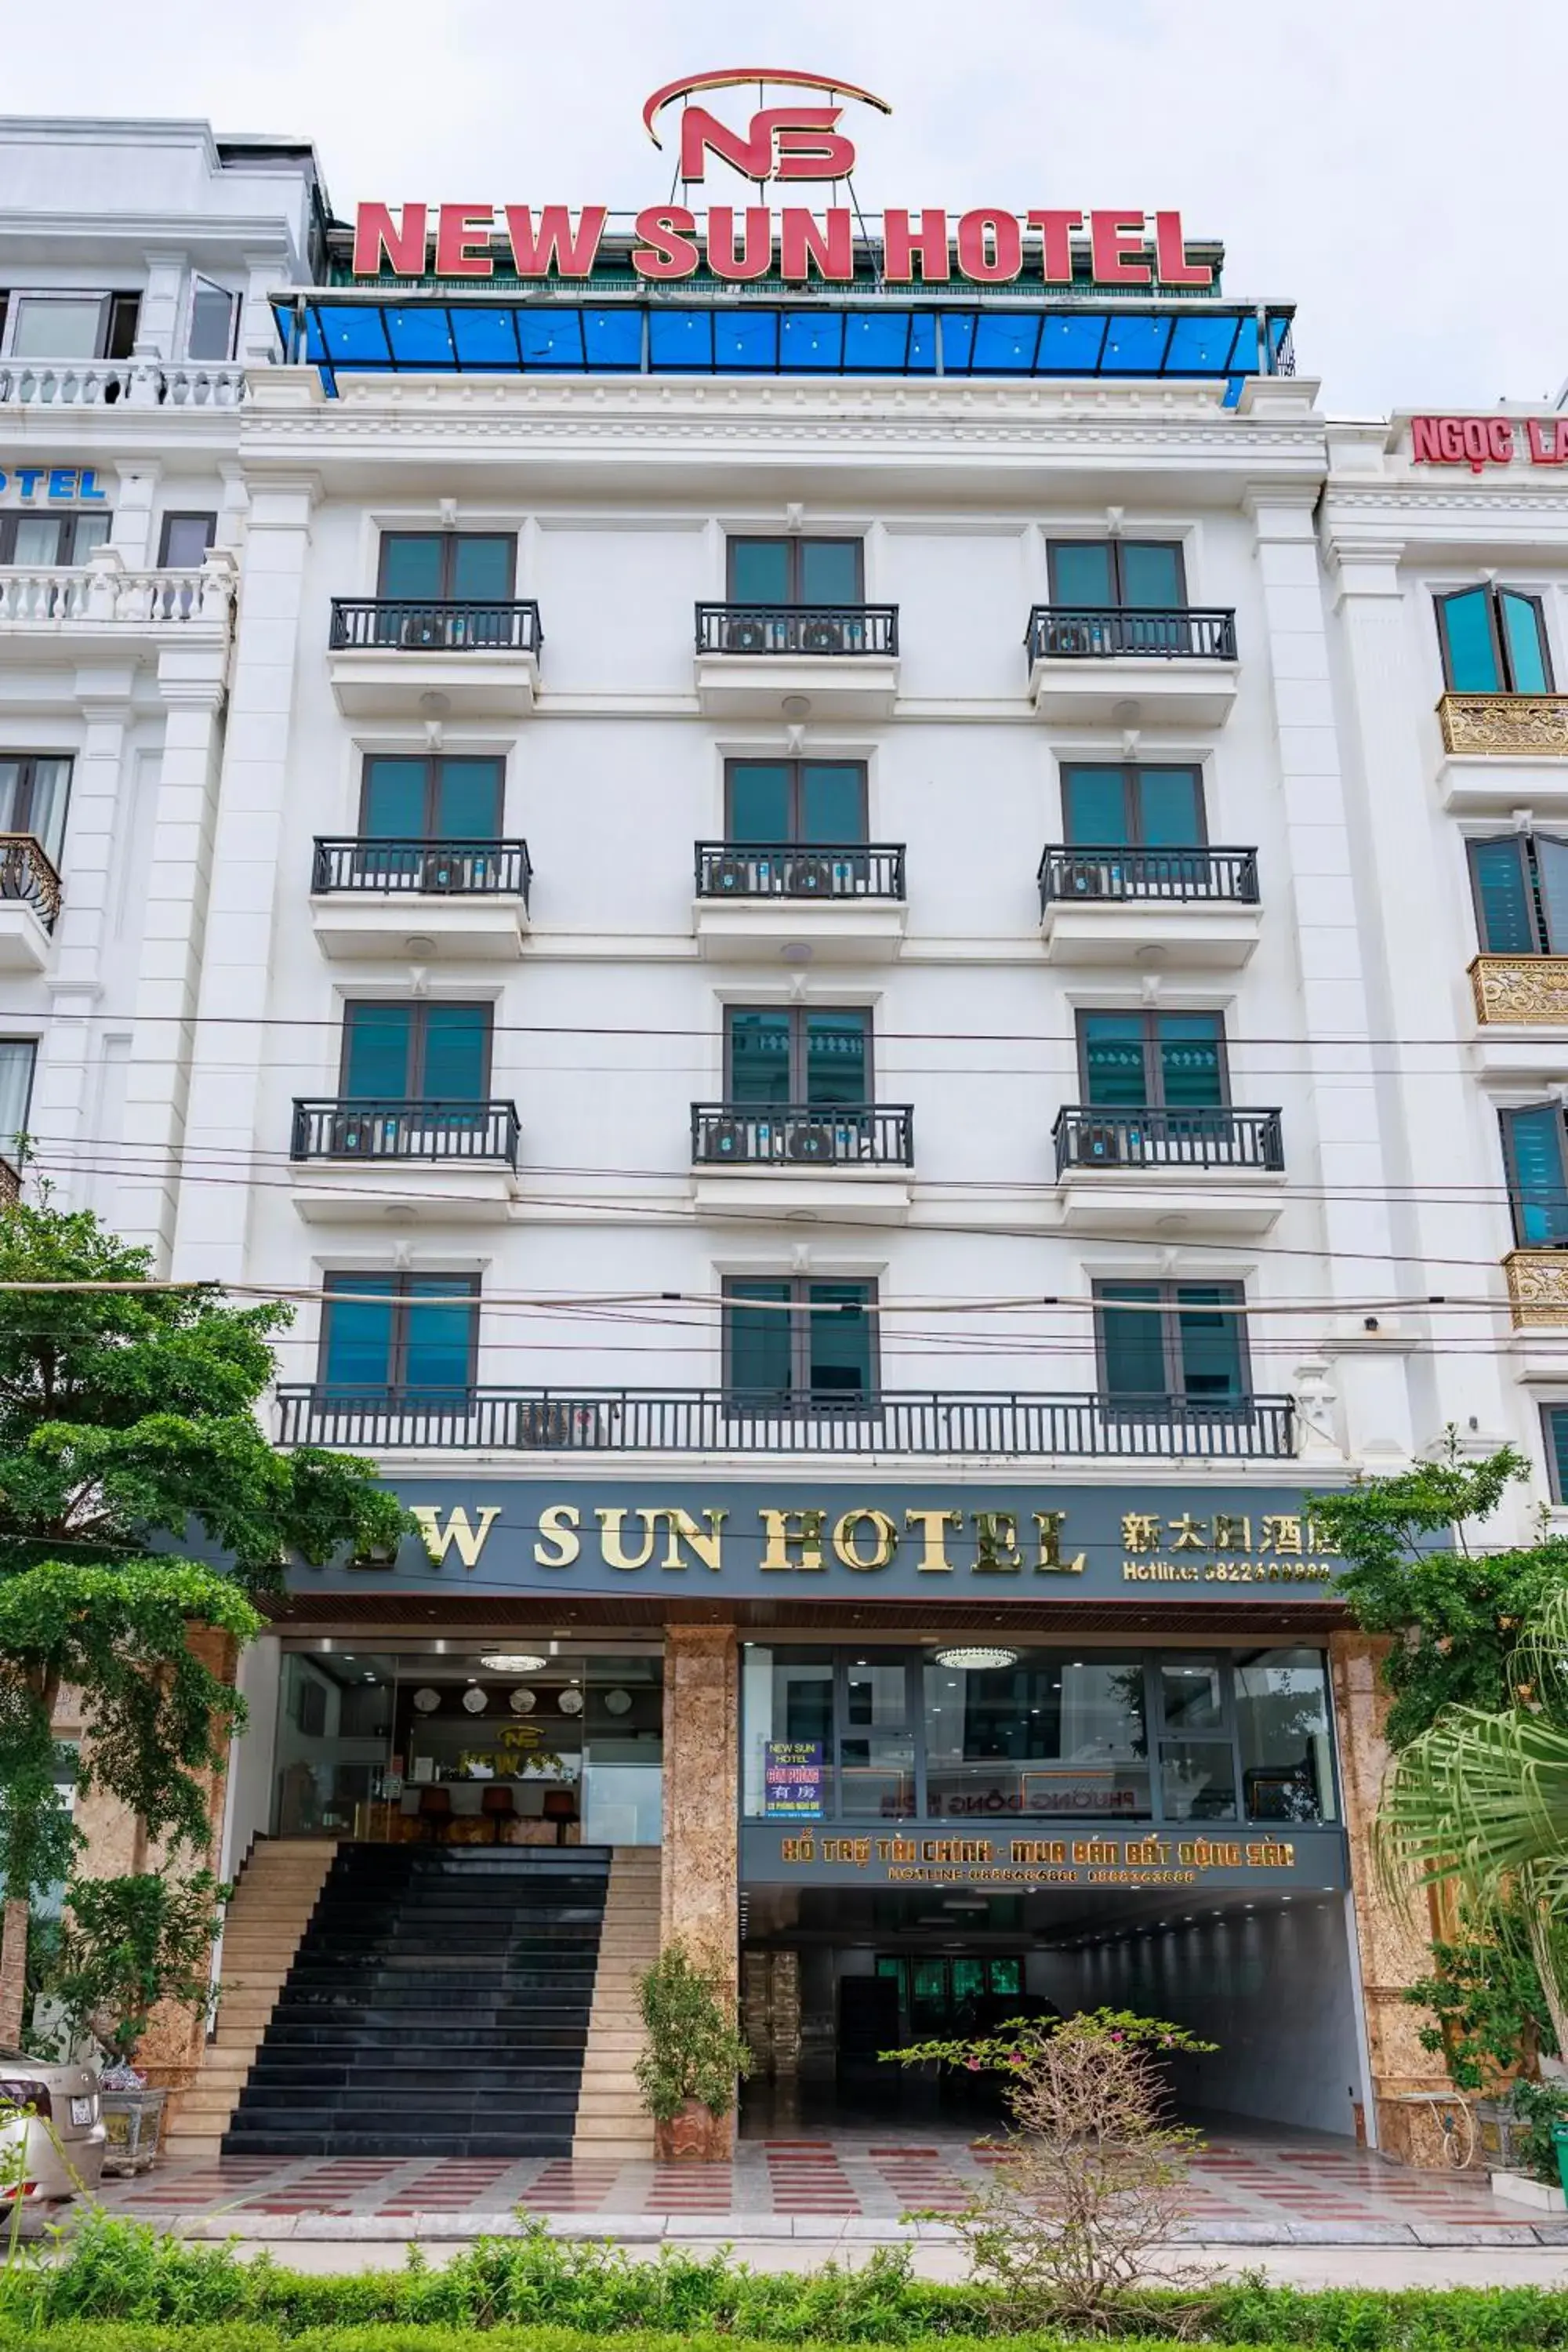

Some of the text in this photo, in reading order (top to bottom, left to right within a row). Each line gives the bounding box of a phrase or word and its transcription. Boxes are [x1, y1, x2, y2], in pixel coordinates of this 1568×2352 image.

[352, 201, 1214, 286] NEW SUN HOTEL
[1412, 416, 1515, 474] NGỌC
[0, 466, 107, 503] TEL
[534, 1504, 730, 1570] SUN
[758, 1508, 1087, 1573] HOTEL
[769, 1743, 815, 1754] NEW SUN
[775, 1755, 809, 1763] HOTEL
